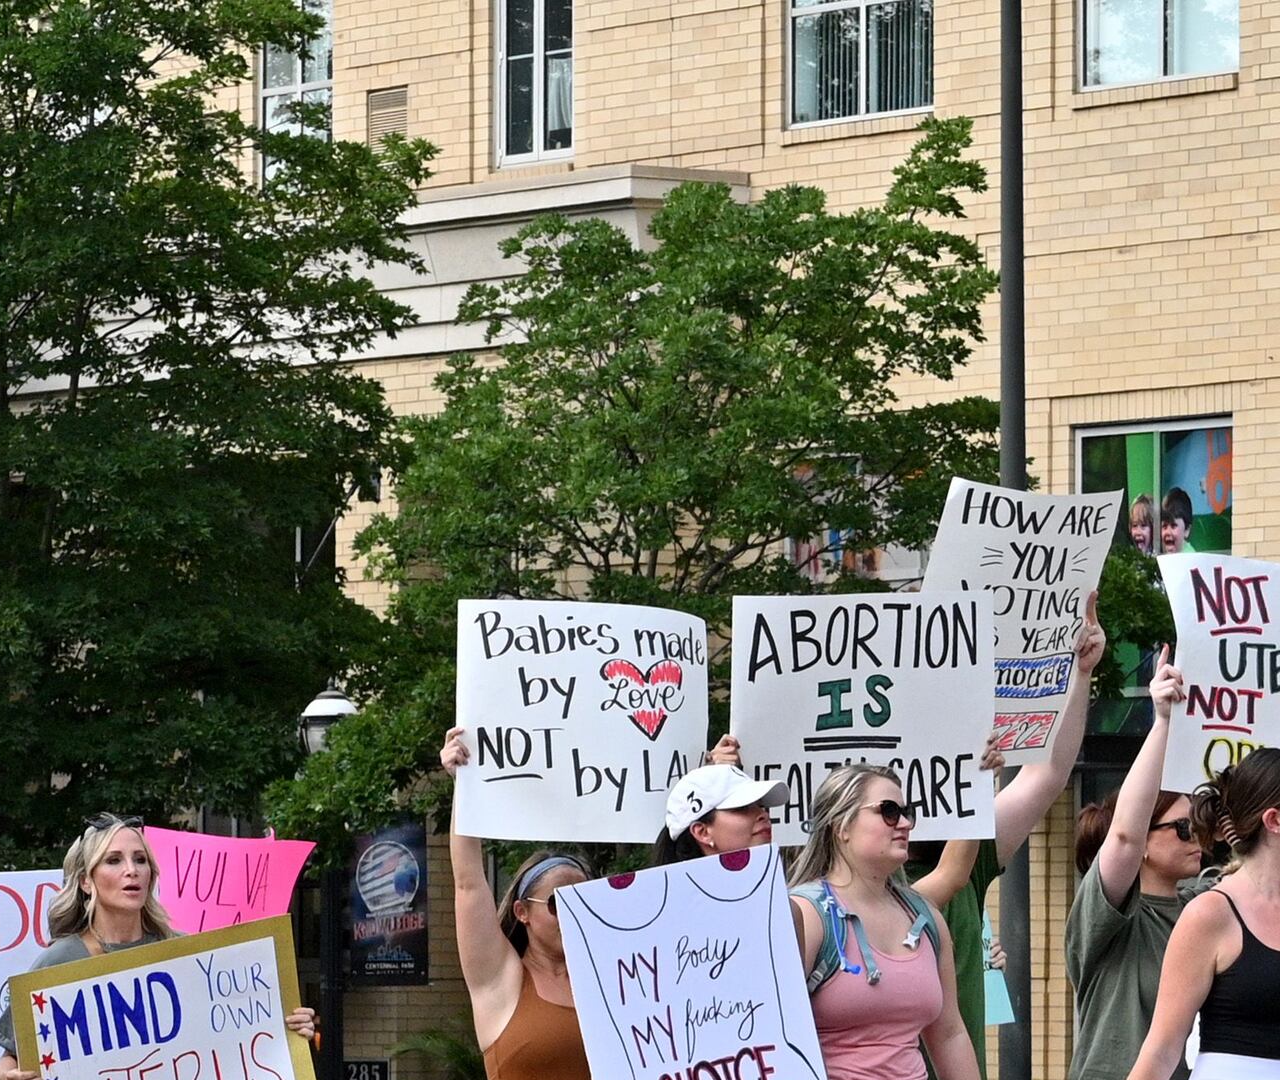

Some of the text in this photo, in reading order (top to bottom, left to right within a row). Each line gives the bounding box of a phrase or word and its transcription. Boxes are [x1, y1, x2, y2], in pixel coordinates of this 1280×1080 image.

[962, 488, 1113, 537] HOW ARE
[1010, 542, 1067, 585] YOU
[985, 585, 1079, 622] OTING
[1190, 567, 1270, 626] NOT
[474, 611, 705, 666] Babies made
[748, 601, 977, 682] ABORTION
[1021, 617, 1083, 653] YEAR?
[519, 667, 685, 719] by Love
[996, 662, 1066, 688] mocrat
[814, 674, 894, 731] IS
[1186, 685, 1263, 724] NOT
[477, 727, 565, 769] NOT
[572, 748, 628, 812] by
[687, 790, 703, 814] 3
[176, 846, 270, 912] VULVA
[618, 936, 740, 1005] MY Body
[49, 953, 270, 1061] MIND YOUR
[210, 991, 272, 1033] OWN
[631, 996, 764, 1068] MY fucking
